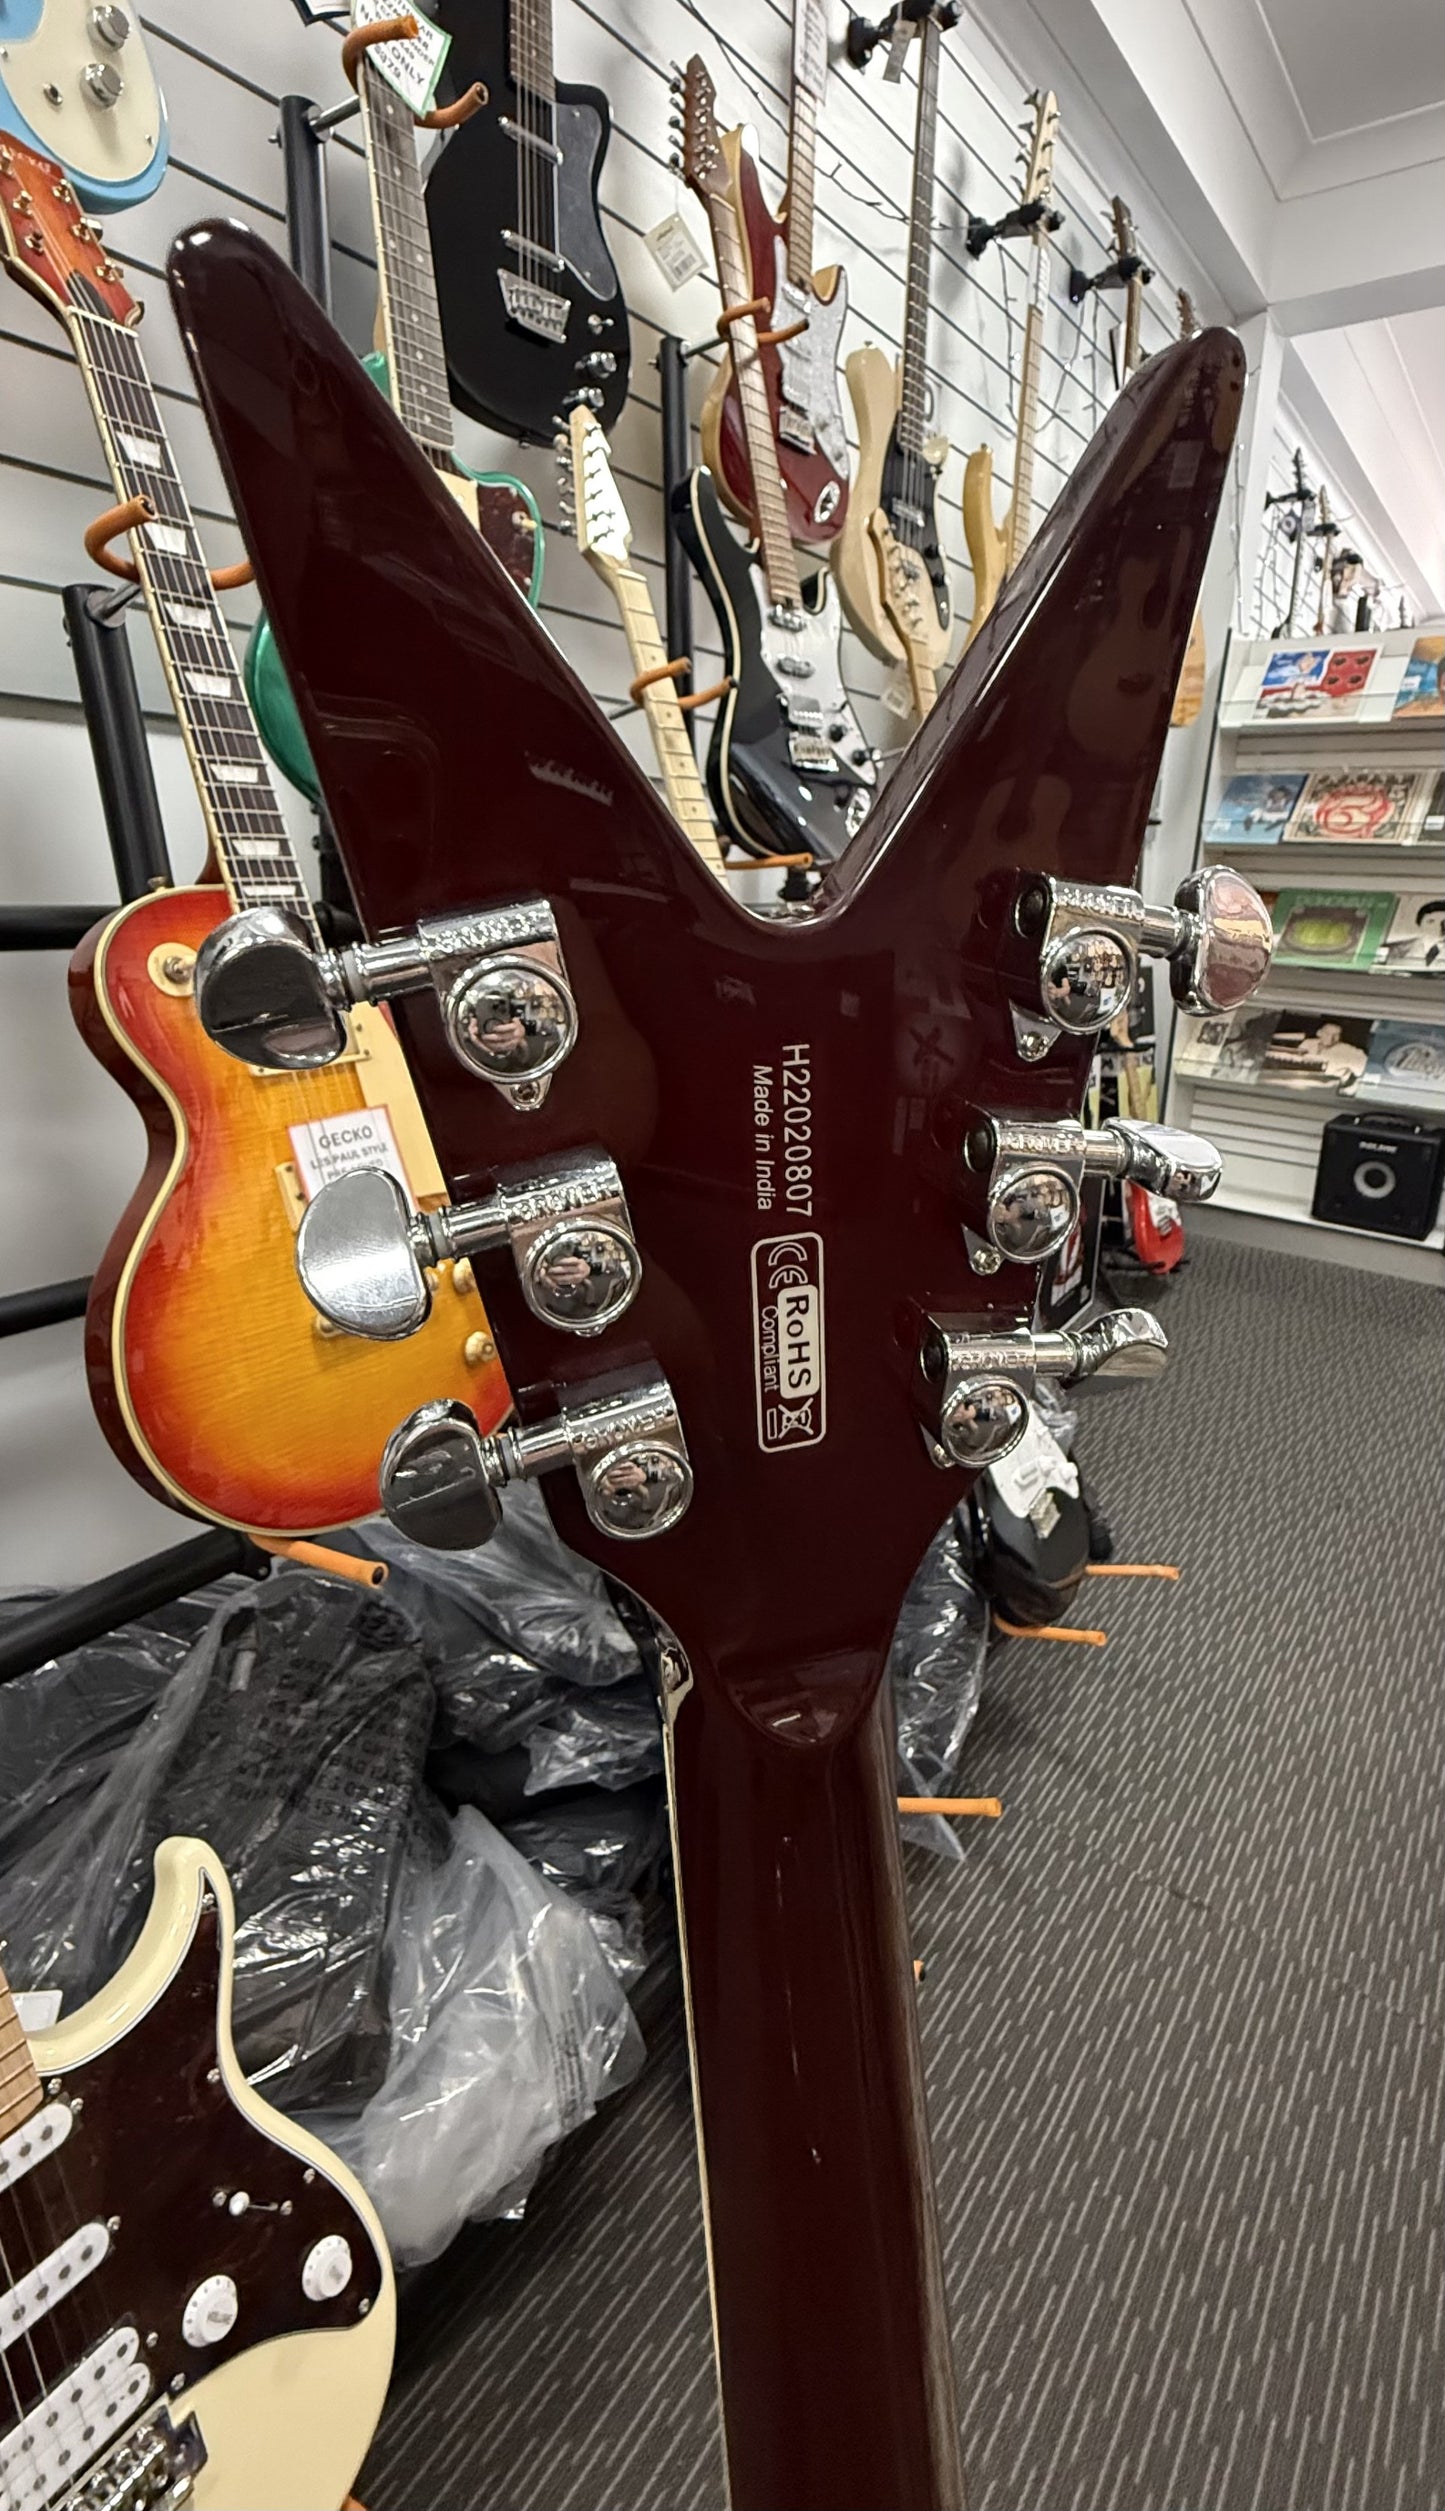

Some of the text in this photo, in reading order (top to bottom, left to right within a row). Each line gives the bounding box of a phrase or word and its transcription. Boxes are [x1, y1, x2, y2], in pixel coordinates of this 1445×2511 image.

[391, 46, 426, 84] ONLY
[319, 1125, 373, 1149] GECKO
[753, 1065, 776, 1210] Made in India
[782, 1044, 813, 1217] H22020807
[761, 1305, 780, 1392] Compliant
[786, 1294, 812, 1389] RoHS
